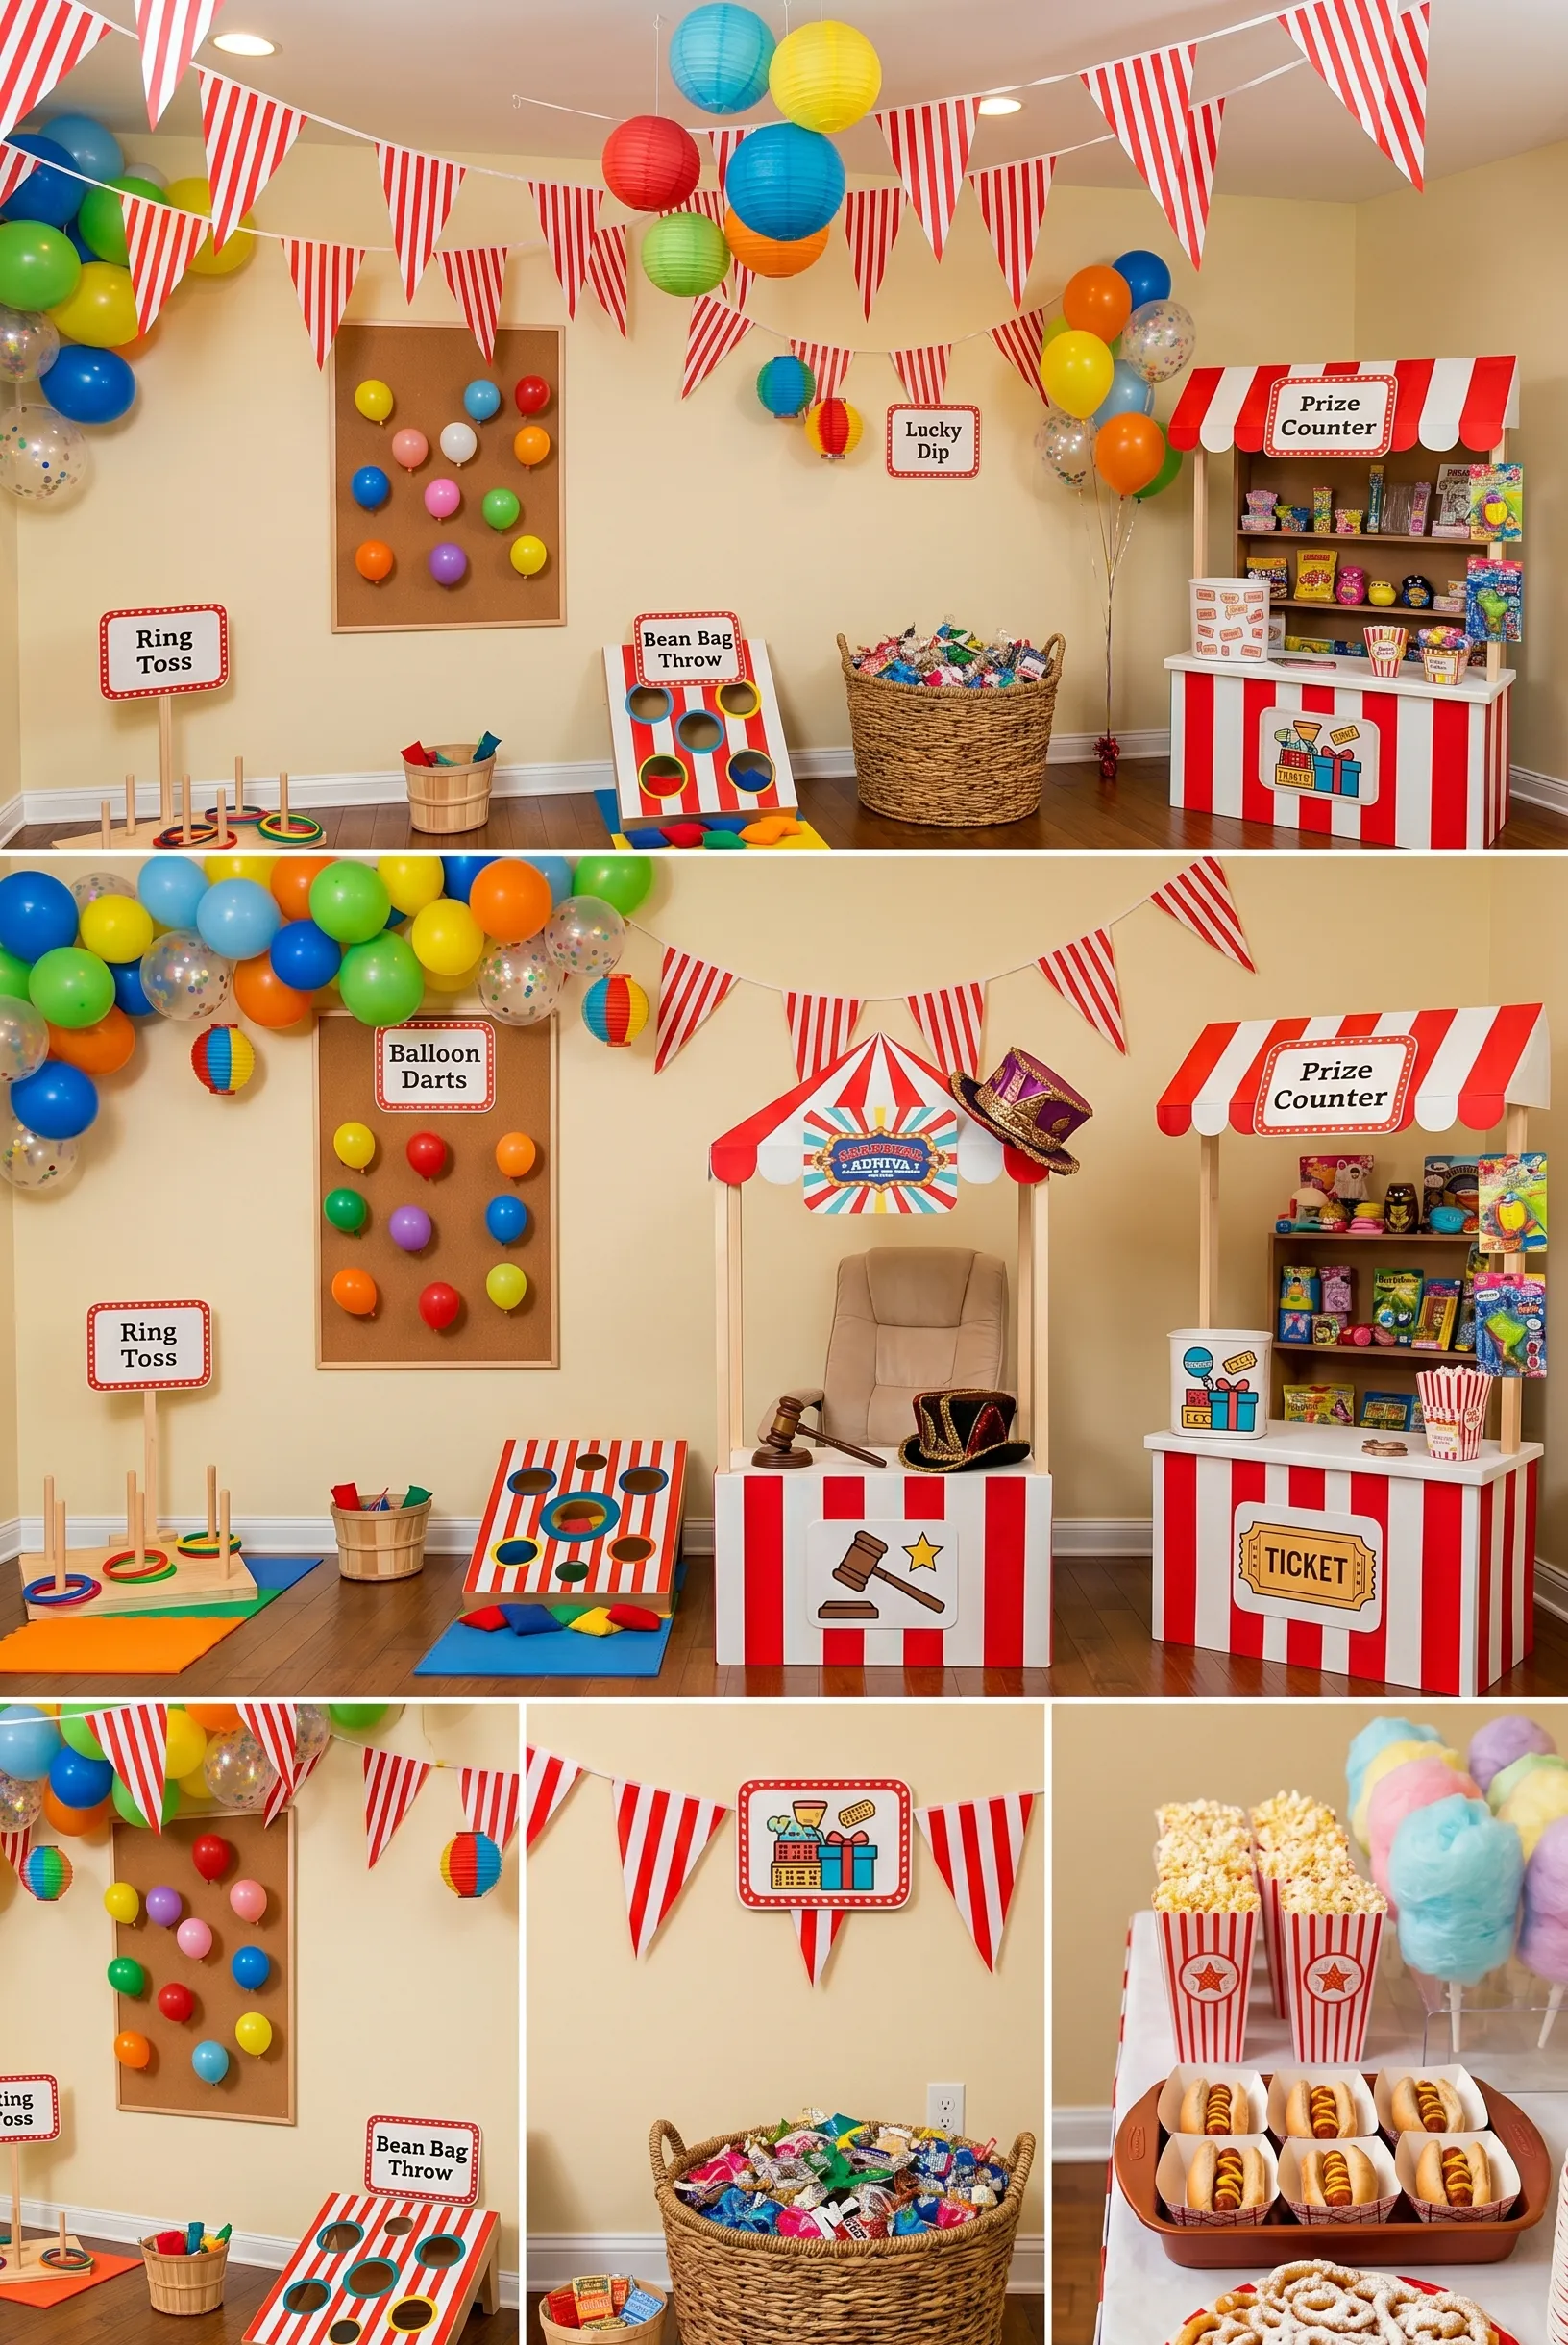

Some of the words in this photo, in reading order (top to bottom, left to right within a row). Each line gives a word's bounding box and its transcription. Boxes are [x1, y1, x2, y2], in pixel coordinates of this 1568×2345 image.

[1300, 395, 1360, 411] Prize
[905, 421, 962, 443] Lucky
[1281, 419, 1377, 435] Counter
[917, 443, 949, 464] Dip
[136, 629, 193, 651] Ring
[643, 632, 691, 647] Bean
[697, 630, 733, 650] Bag
[136, 655, 192, 674] Toss
[658, 653, 722, 668] Throw
[389, 1043, 481, 1063] Balloon
[401, 1070, 467, 1089] Darts
[1299, 1061, 1373, 1081] Prize
[1274, 1088, 1388, 1110] Counter
[120, 1322, 177, 1345] Ring
[120, 1349, 177, 1368] Toss
[1264, 1546, 1348, 1584] TICKET
[0, 2091, 33, 2110] ing
[0, 2111, 33, 2126] oss
[376, 2135, 425, 2155] Bean
[429, 2140, 469, 2164] Bag
[388, 2160, 453, 2181] Throw
